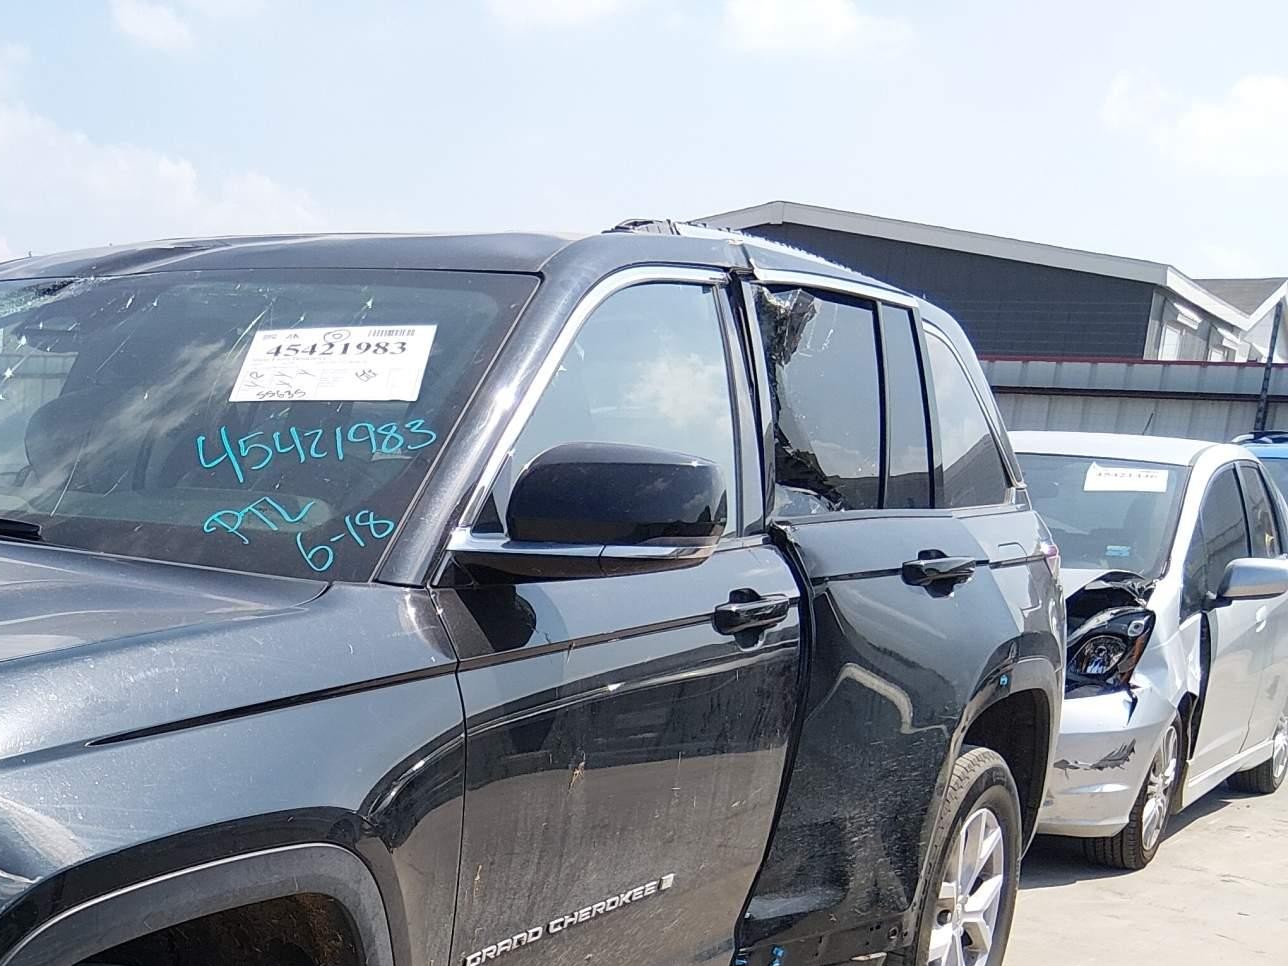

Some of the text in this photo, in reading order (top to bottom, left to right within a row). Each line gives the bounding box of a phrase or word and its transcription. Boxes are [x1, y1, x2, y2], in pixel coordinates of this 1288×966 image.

[266, 341, 407, 357] 45421983
[196, 418, 438, 483] 45421983
[296, 510, 395, 573] 6-18
[547, 880, 659, 935] CHEROKEE
